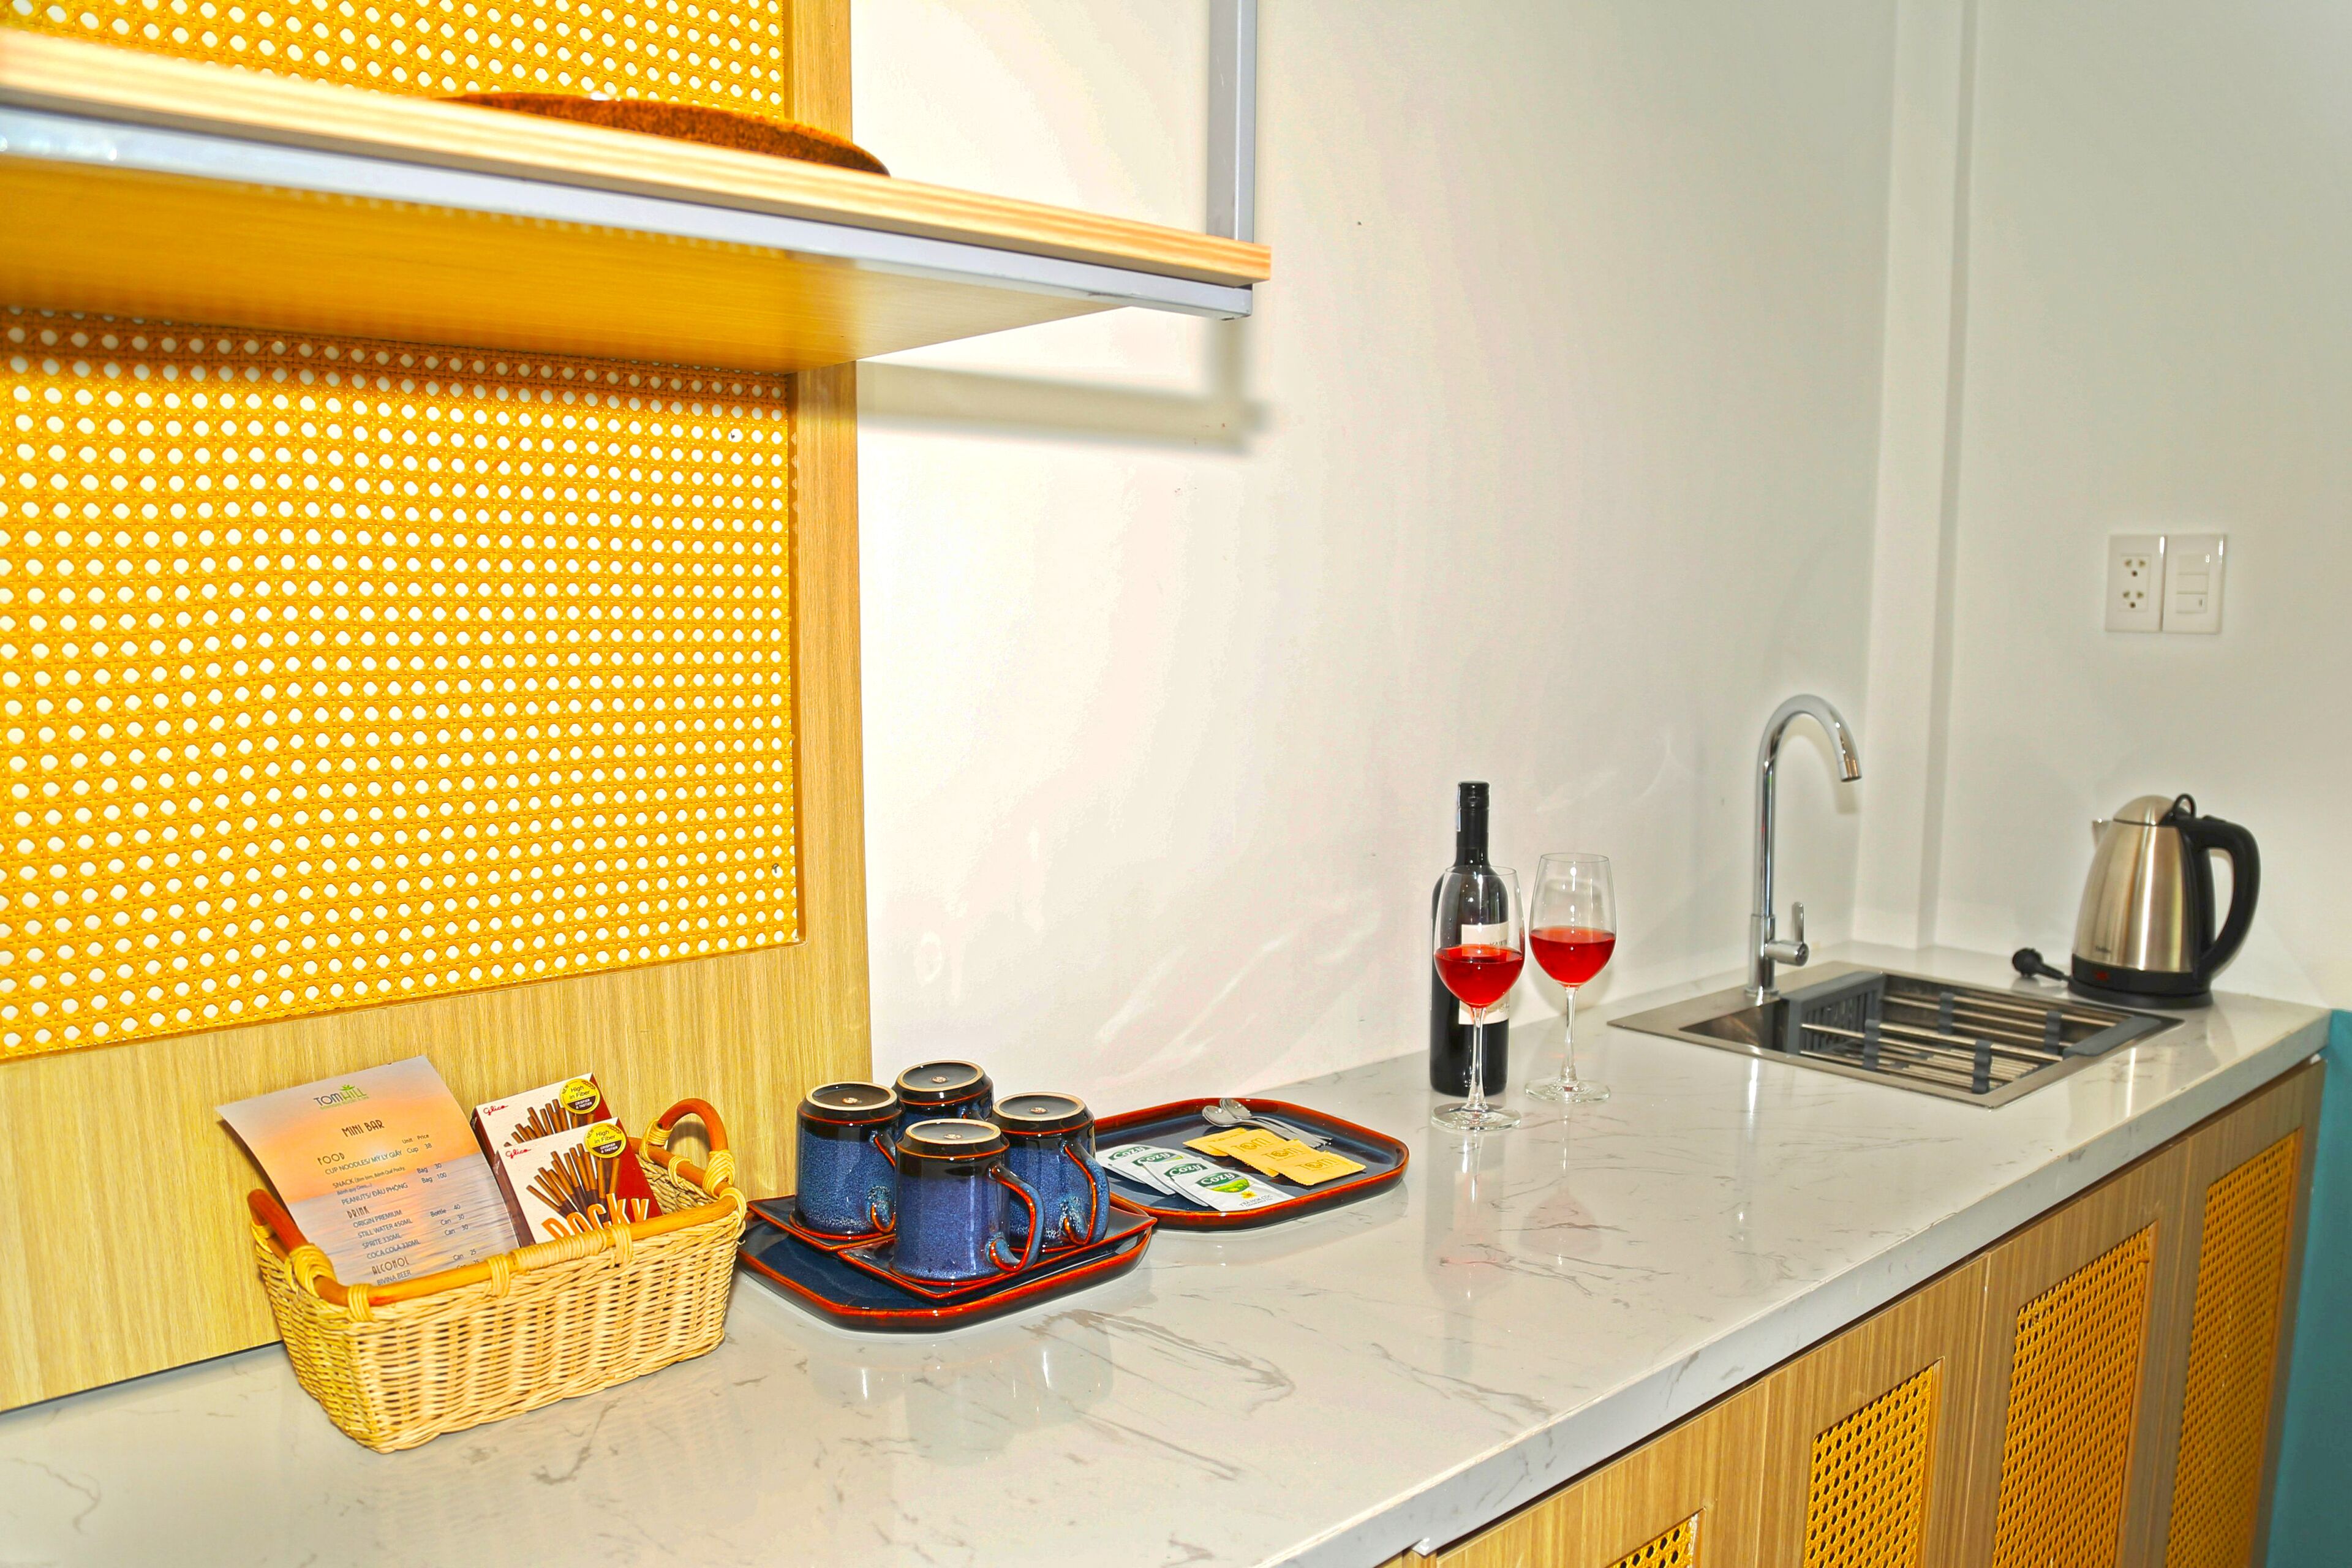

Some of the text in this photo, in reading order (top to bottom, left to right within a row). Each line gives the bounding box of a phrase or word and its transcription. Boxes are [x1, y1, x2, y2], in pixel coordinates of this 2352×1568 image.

[313, 1088, 367, 1106] TOMHILL
[576, 1090, 590, 1098] Fiber
[483, 1106, 508, 1115] Glico
[341, 1119, 385, 1137] MINI BAR
[317, 1152, 345, 1166] FOOD
[505, 1149, 532, 1159] Glico
[1113, 1147, 1145, 1159] Cozy
[1137, 1152, 1170, 1164] Cozy
[1169, 1164, 1203, 1176] Cozy
[333, 1178, 355, 1189] SNACK
[1200, 1172, 1235, 1185] Cozy
[347, 1205, 370, 1219] DRINK
[430, 1208, 447, 1218] Bottle
[353, 1209, 402, 1228] ORIGIN PREMIUM
[358, 1218, 413, 1238] STILL WATER 450ML
[362, 1238, 383, 1249] SPRITE
[383, 1233, 402, 1243] 330ML
[367, 1250, 385, 1259] COCA
[372, 1256, 409, 1275] ALCOHOL
[397, 1270, 411, 1280] BEER
